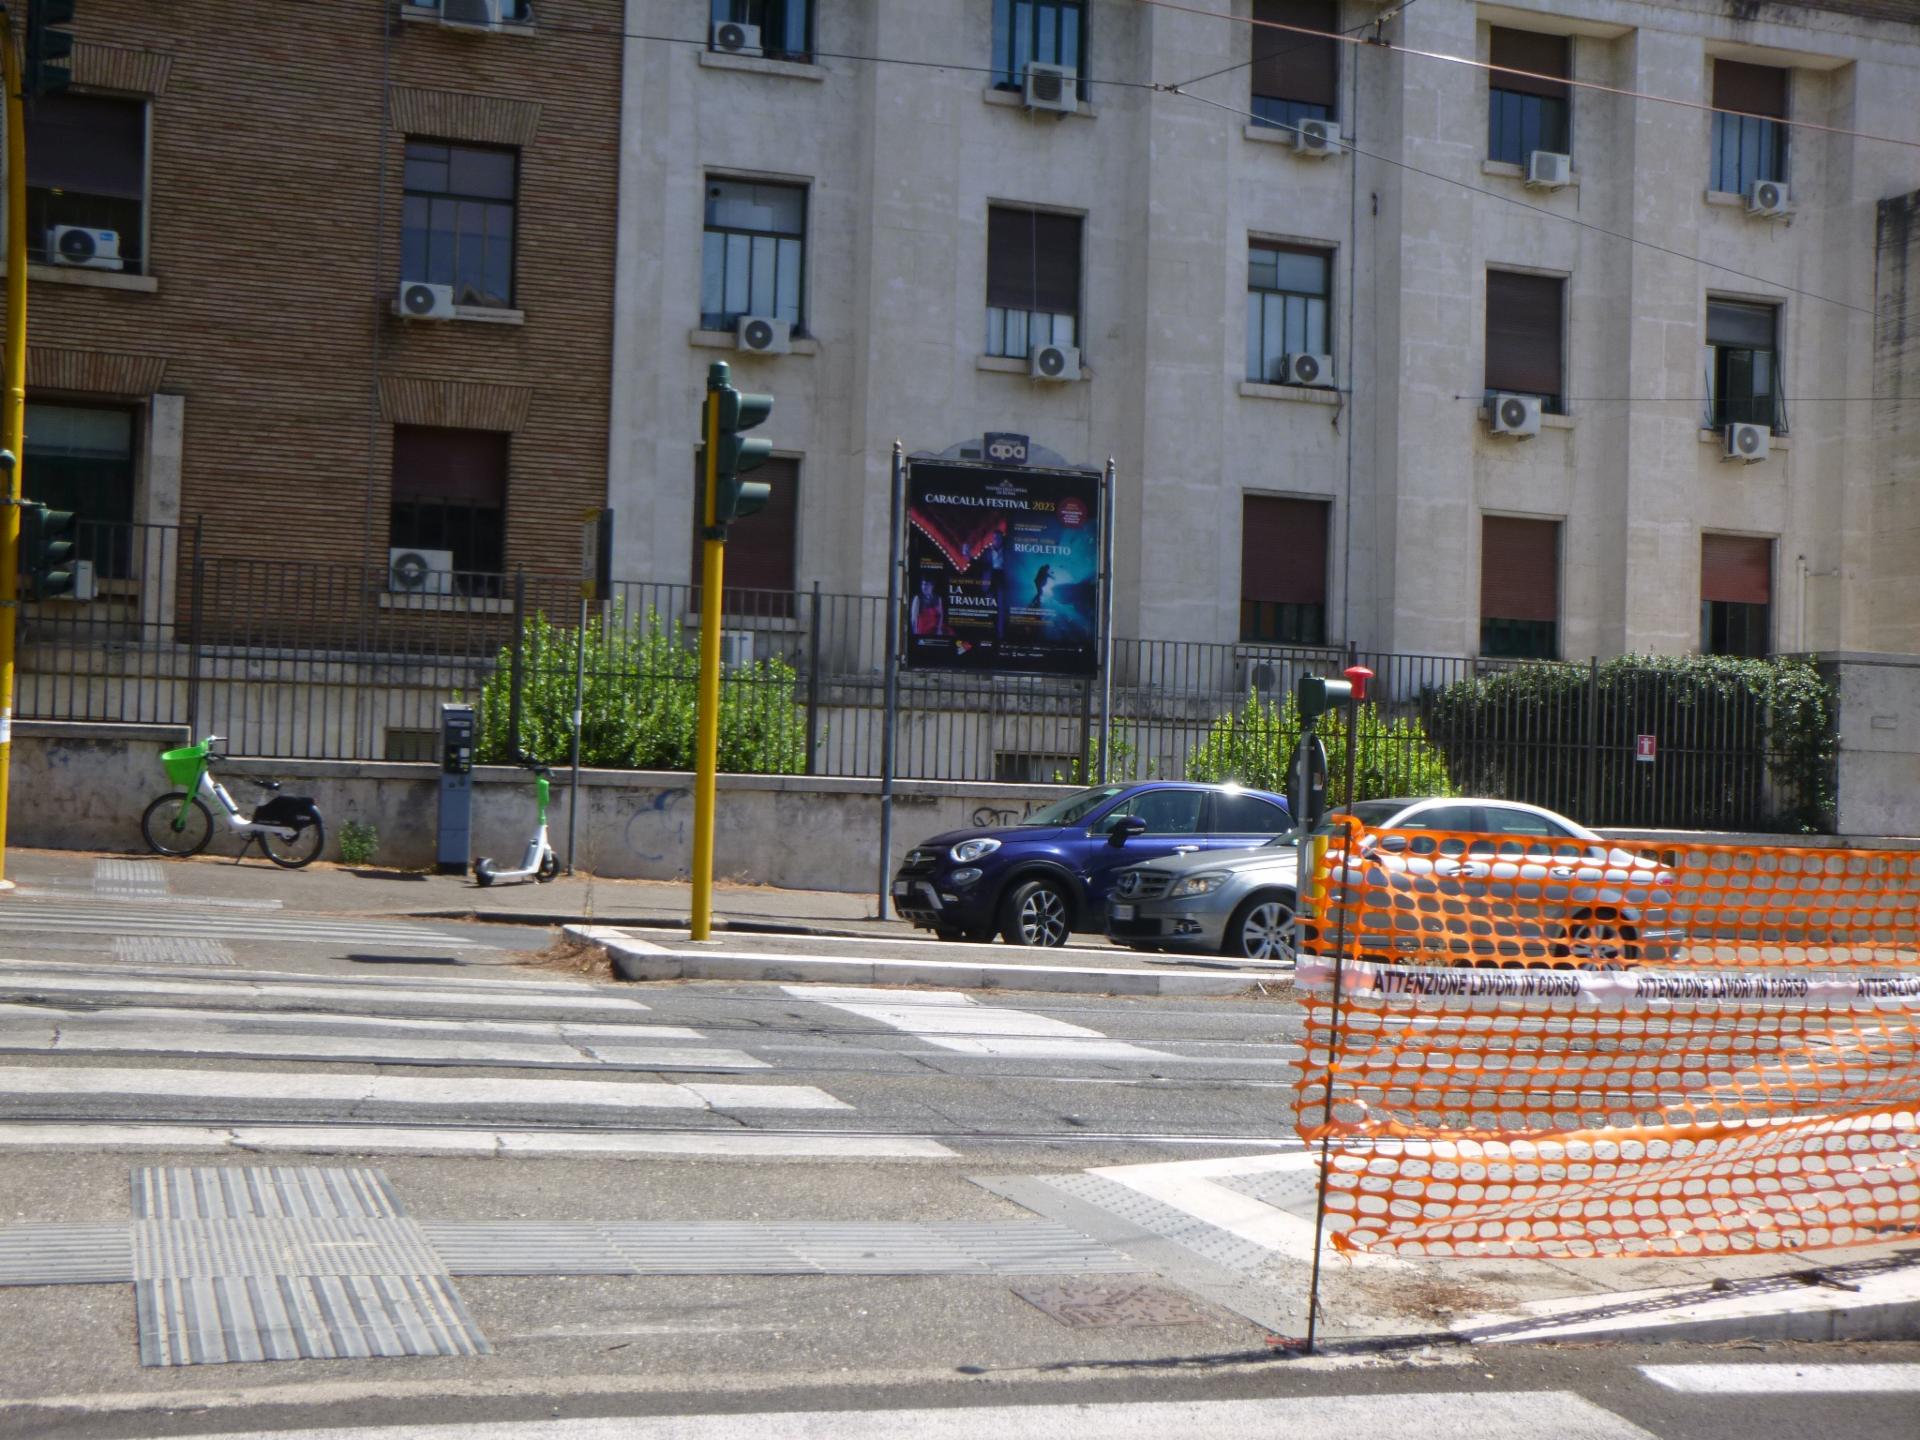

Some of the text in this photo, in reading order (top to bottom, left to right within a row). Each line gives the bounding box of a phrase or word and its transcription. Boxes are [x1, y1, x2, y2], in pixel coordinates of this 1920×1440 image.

[925, 493, 985, 507] CARACALLA
[986, 497, 1031, 510] FESTIVAL
[1014, 543, 1072, 556] RIGOLETTO
[948, 584, 963, 595] LA
[948, 595, 998, 607] TRAVIATA
[1372, 970, 1581, 998] ATTENZIONE LAVORI IN CORSO
[1635, 977, 1809, 998] ATTENZIONE LAVORI IN CORSO
[1856, 977, 1920, 997] ATTENZIO
